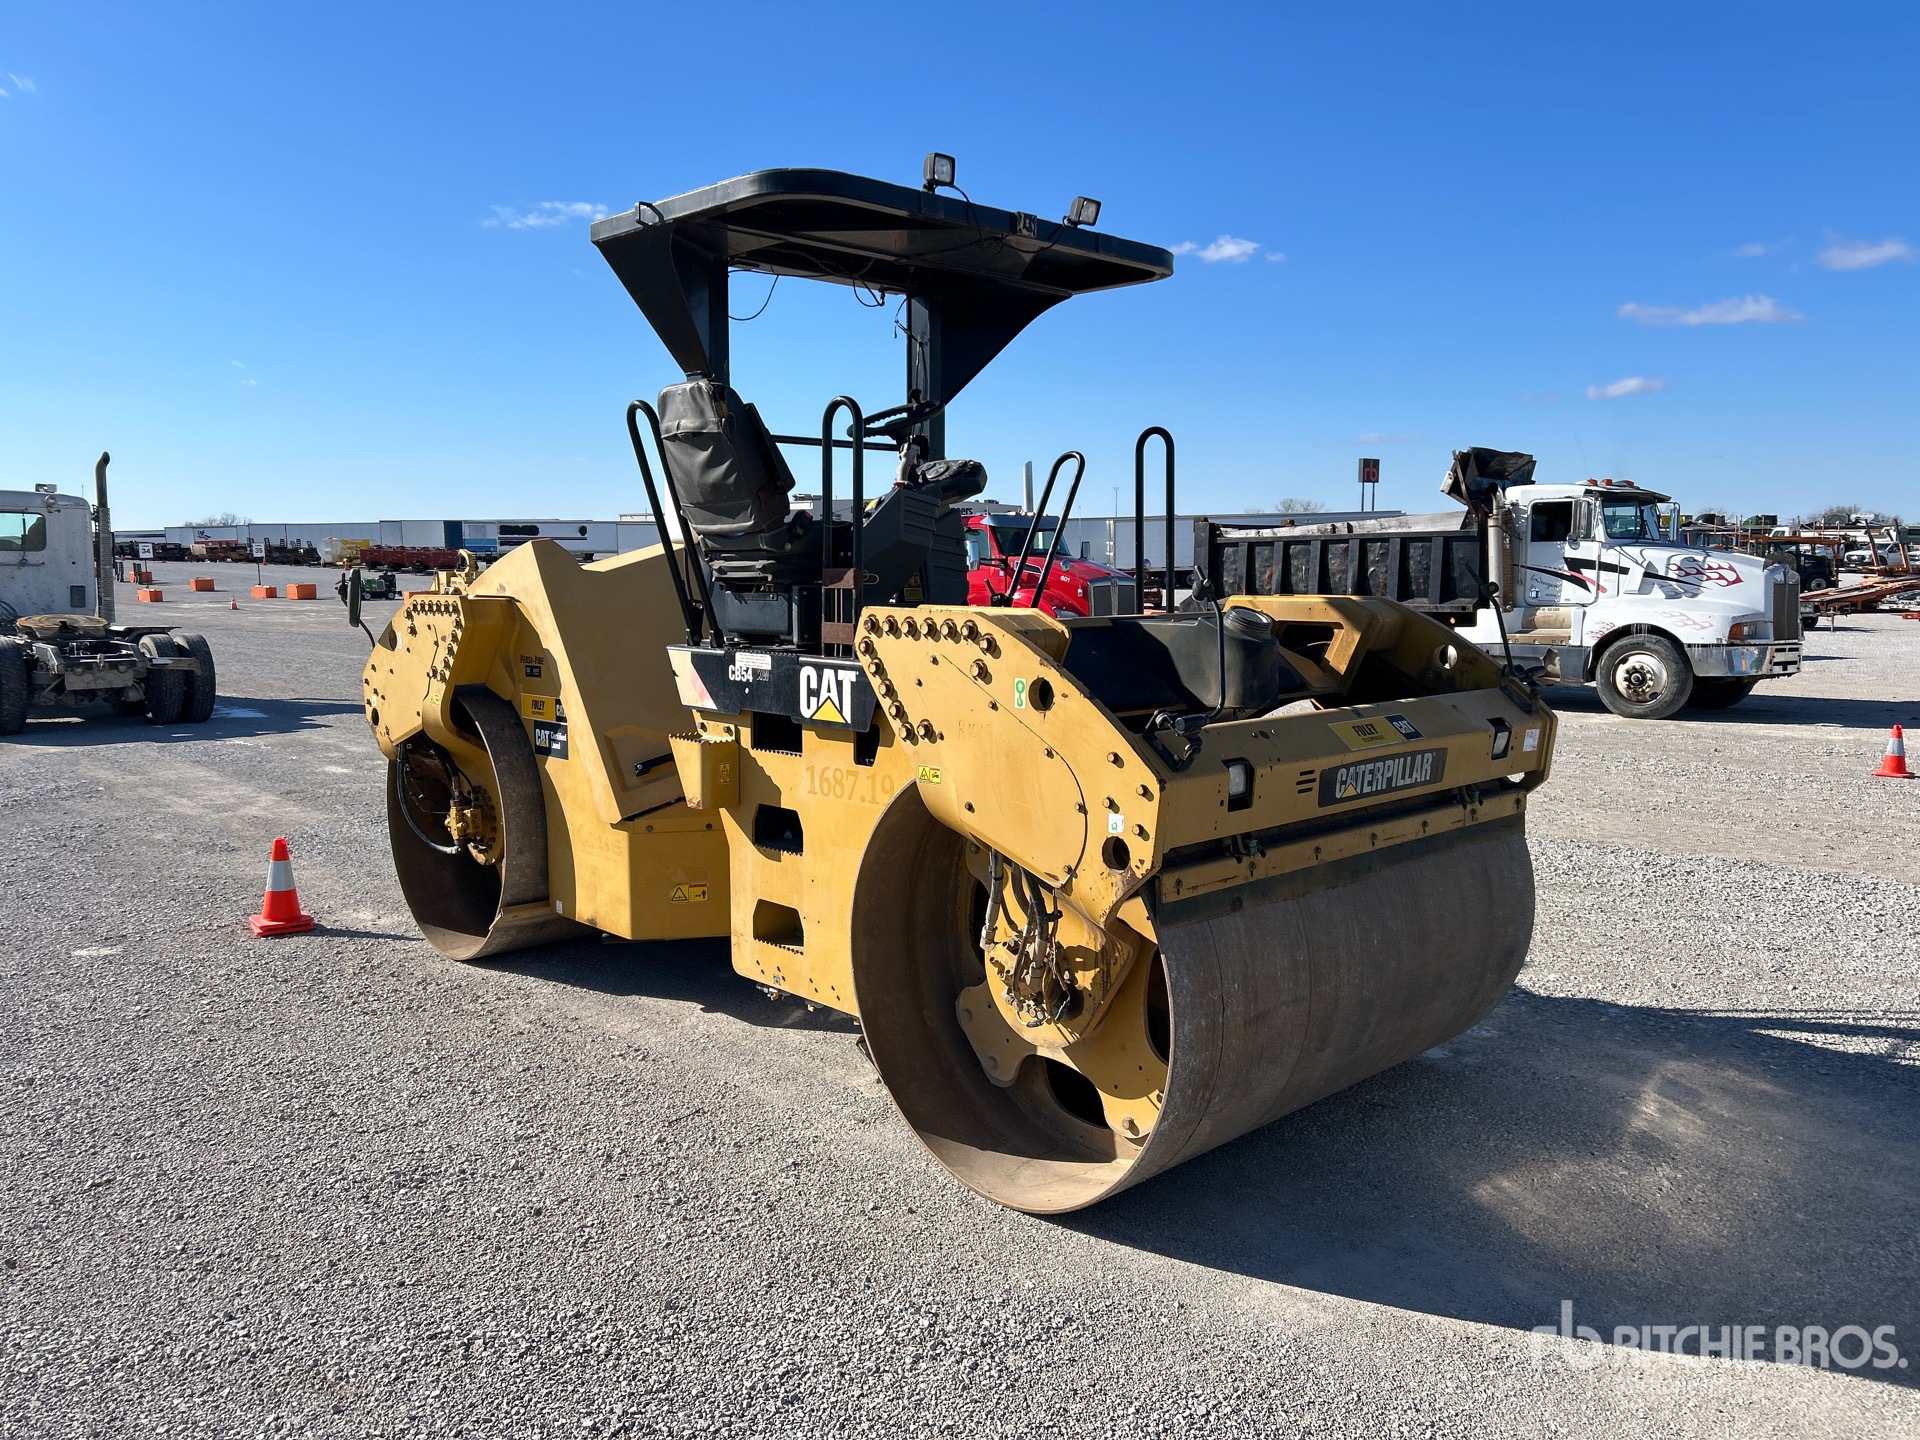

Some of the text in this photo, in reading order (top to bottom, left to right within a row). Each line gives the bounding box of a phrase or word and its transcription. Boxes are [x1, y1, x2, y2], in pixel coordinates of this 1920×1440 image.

[141, 547, 151, 555] 34
[728, 664, 753, 682] CB54
[799, 665, 857, 724] CAT
[532, 700, 545, 710] FOLEY
[1352, 723, 1378, 736] FOLEY
[1392, 720, 1415, 734] CAT
[536, 728, 566, 747] CAT Certified
[1335, 753, 1433, 799] CATERPILLAR
